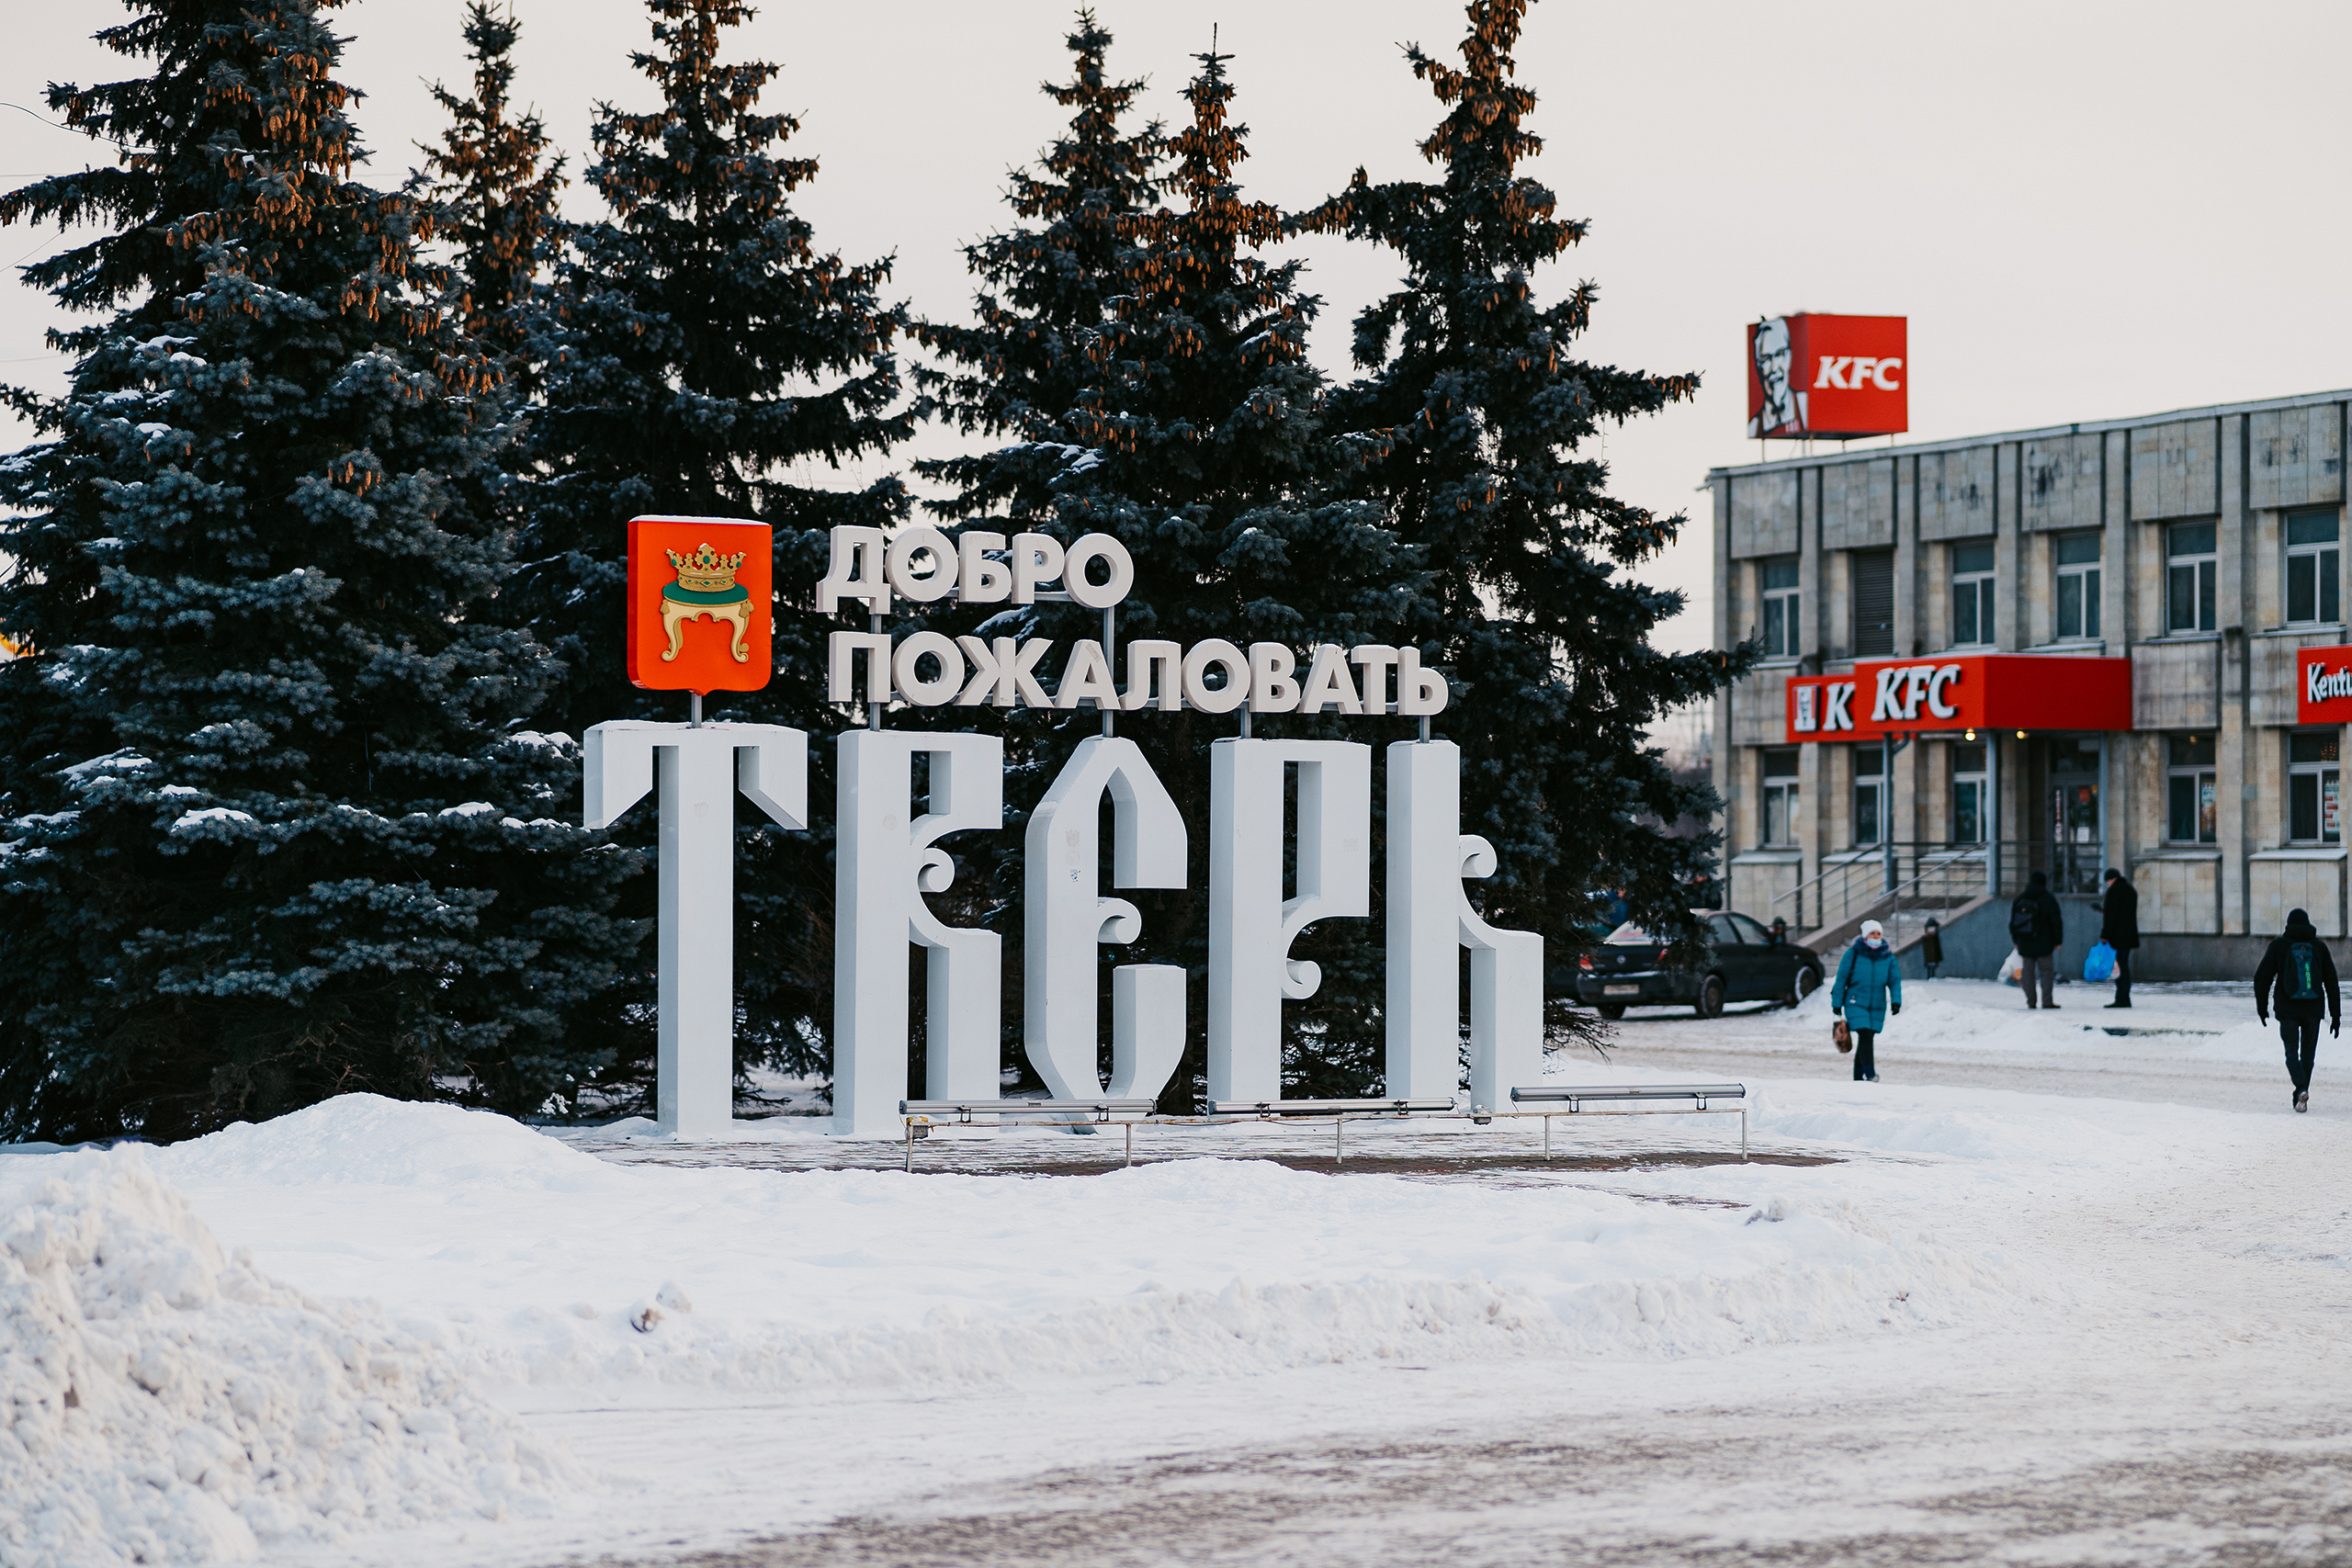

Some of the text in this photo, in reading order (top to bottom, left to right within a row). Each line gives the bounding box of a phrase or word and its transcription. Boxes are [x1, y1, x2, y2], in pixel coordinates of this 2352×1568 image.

[1813, 355, 1903, 391] KFC
[816, 525, 1135, 615] ДОБРО
[829, 631, 1449, 716] ПОЖАЛОВАТЬ
[1871, 664, 1962, 720] KFC
